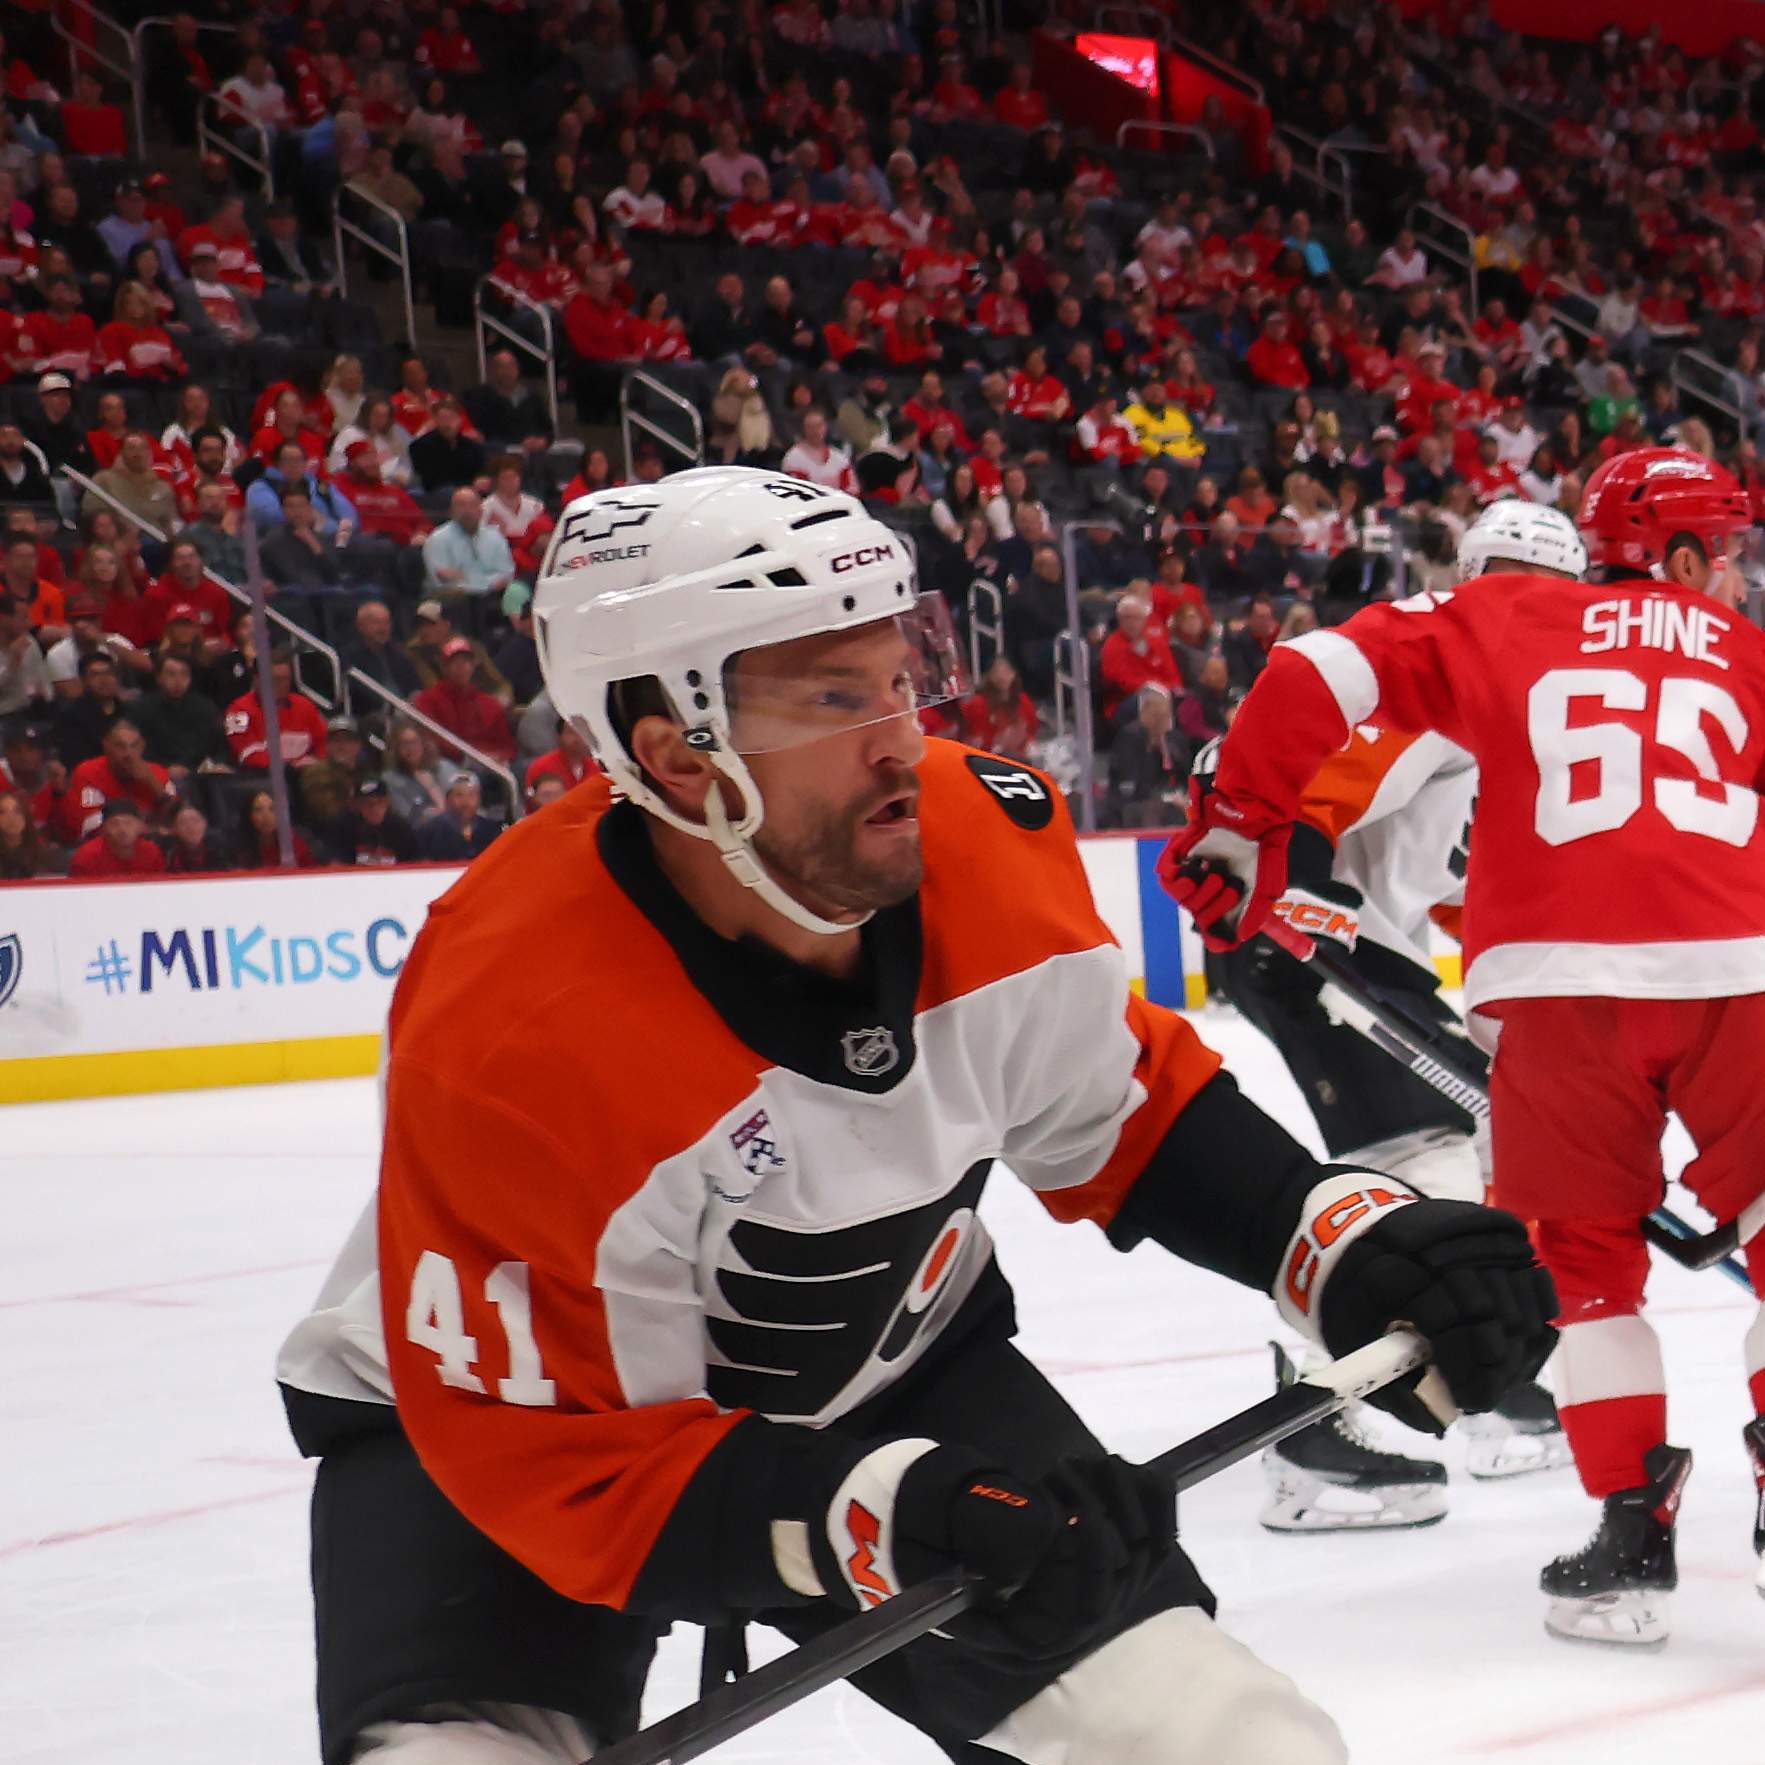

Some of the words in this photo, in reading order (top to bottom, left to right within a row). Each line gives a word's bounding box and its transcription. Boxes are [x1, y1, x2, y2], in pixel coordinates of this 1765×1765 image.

[556, 543, 652, 577] EVROLET
[831, 545, 895, 573] CCM
[1580, 597, 1731, 671] SHINE
[1528, 667, 1759, 848] 65
[407, 1249, 557, 1406] 41
